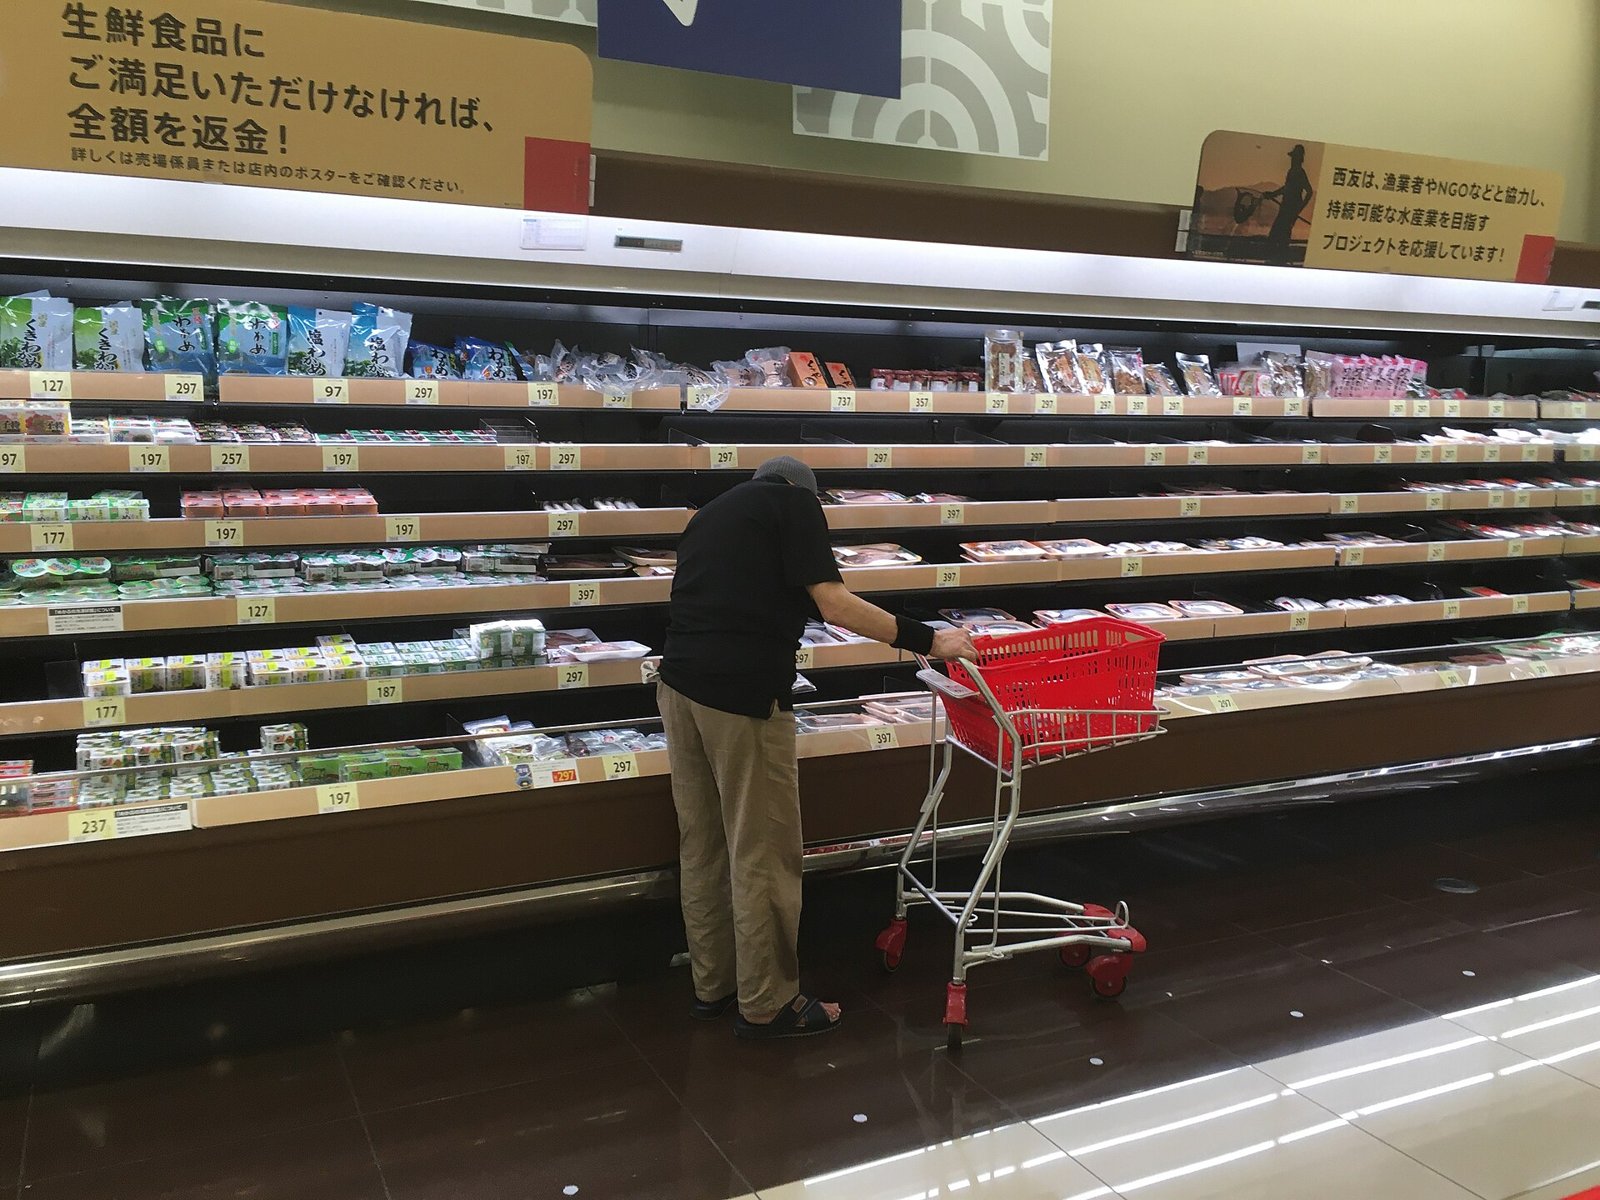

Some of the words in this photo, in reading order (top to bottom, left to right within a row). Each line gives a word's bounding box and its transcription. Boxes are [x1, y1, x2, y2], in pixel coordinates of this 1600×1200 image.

[62, 2, 266, 59] 生鮮食品に
[68, 54, 496, 133] ご満足いただけなければ、
[67, 103, 288, 155] 全額を返金！
[71, 147, 464, 194] 詳しくは売場係員または店内のポスターをご確認ください。
[1332, 167, 1545, 207] 西友は、漁業者やNGOなどと協力し、
[1327, 200, 1490, 232] 持続可能な水産業を目指す
[1323, 234, 1505, 263] プロジェクトを応援しています！
[43, 380, 63, 391] 127
[177, 383, 196, 394] 297
[325, 386, 341, 397] 97
[415, 388, 432, 398] 297
[537, 390, 552, 399] 197
[838, 397, 851, 406] 737
[916, 398, 928, 407] 357
[993, 400, 1004, 408] 297
[141, 454, 161, 465] 197
[222, 454, 242, 464] 257
[333, 454, 351, 465] 197
[516, 455, 529, 464] 197
[559, 454, 575, 464] 297
[718, 452, 732, 462] 297
[875, 454, 887, 462] 297
[948, 510, 960, 518] 397
[396, 525, 413, 535] 197
[557, 520, 573, 530] 297
[43, 532, 64, 543] 177
[217, 528, 236, 539] 197
[943, 573, 956, 582] 397
[579, 590, 594, 600] 397
[248, 606, 267, 617] 127
[567, 672, 582, 682] 297
[378, 686, 395, 697] 187
[96, 706, 117, 718] 177
[877, 733, 890, 743] 397
[614, 761, 630, 772] 297
[330, 792, 350, 804] 197
[82, 819, 106, 834] 237
